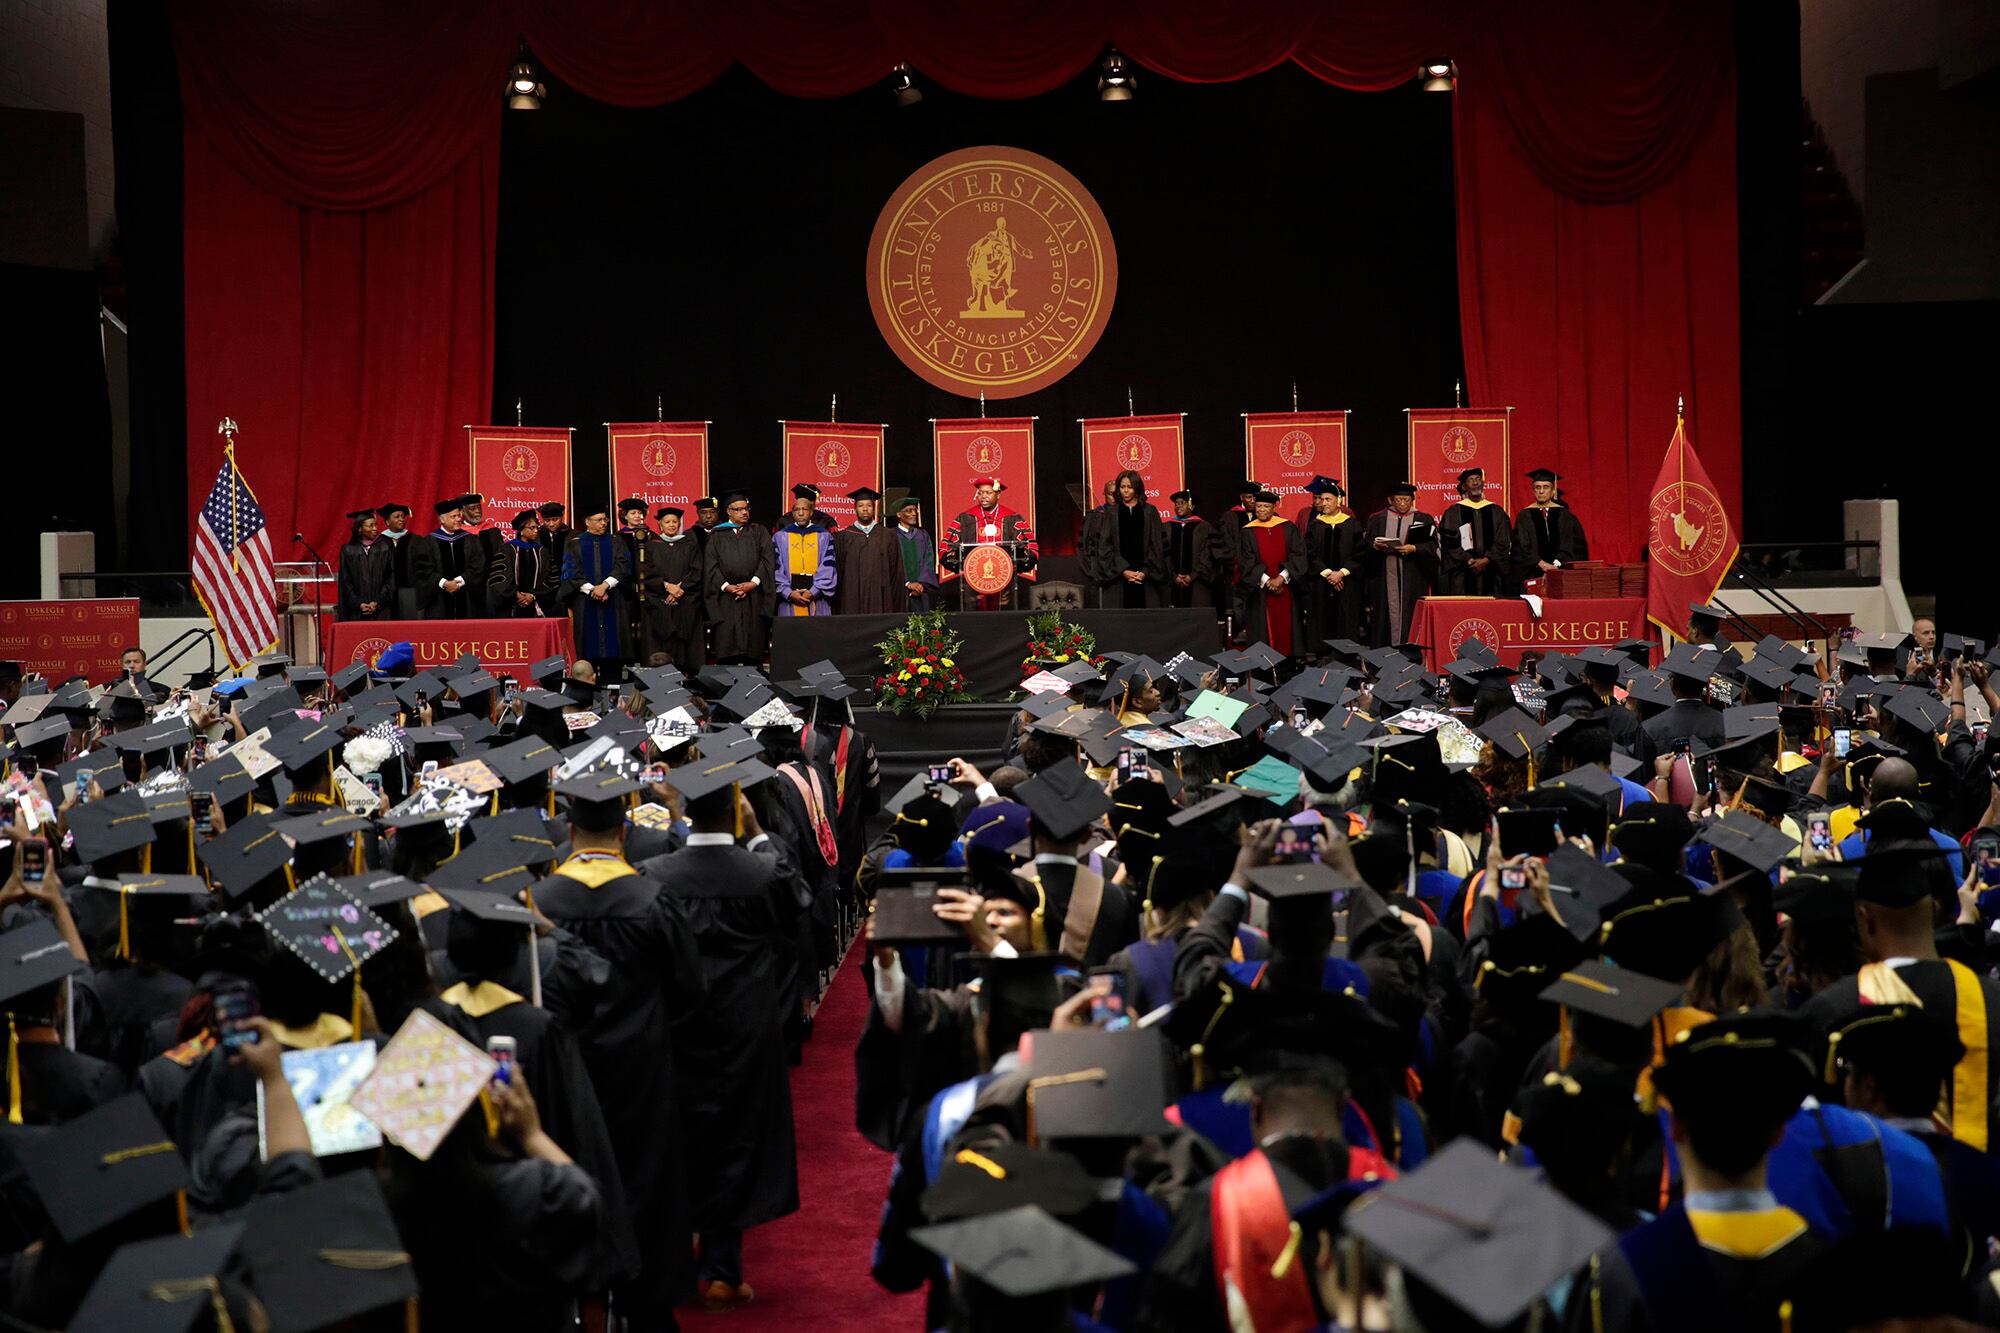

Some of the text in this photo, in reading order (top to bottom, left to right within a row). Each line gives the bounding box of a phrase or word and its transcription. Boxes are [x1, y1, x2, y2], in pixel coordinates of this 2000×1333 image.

[895, 172, 1088, 257] UNIVERSITAS
[976, 202, 1005, 213] 1881
[920, 231, 1065, 346] SCIENTIA PRINCIPATUS OPERA
[893, 273, 1092, 374] TUSKEGEENSIS
[632, 492, 689, 504] Education
[1262, 482, 1310, 496] Engine
[95, 605, 136, 613] TUSKEGEE
[1501, 621, 1629, 642] TUSKEGEE
[409, 640, 529, 661] USKEGEE
